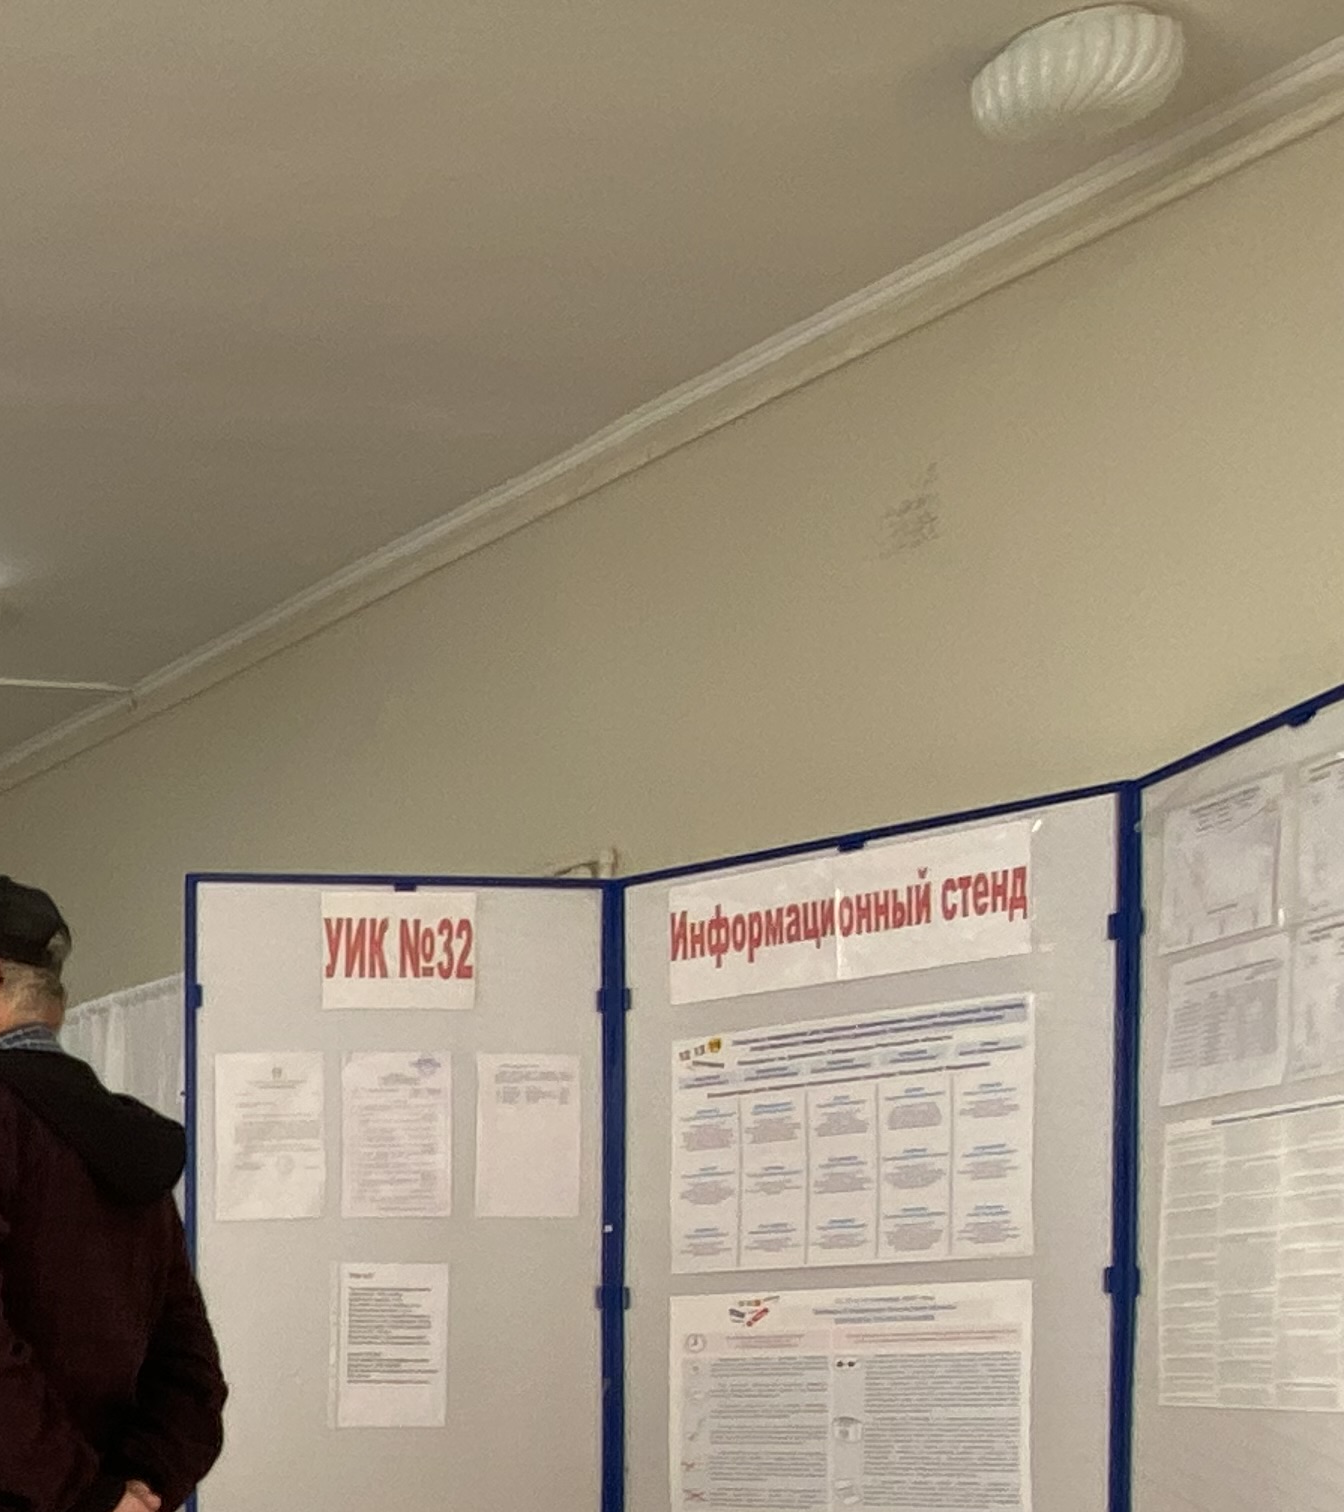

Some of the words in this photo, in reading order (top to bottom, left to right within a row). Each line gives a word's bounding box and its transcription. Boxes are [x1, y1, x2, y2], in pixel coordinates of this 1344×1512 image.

[324, 917, 389, 978] УИК
[399, 917, 473, 979] №32
[670, 867, 932, 968] Информационный
[941, 866, 1028, 922] стенд
